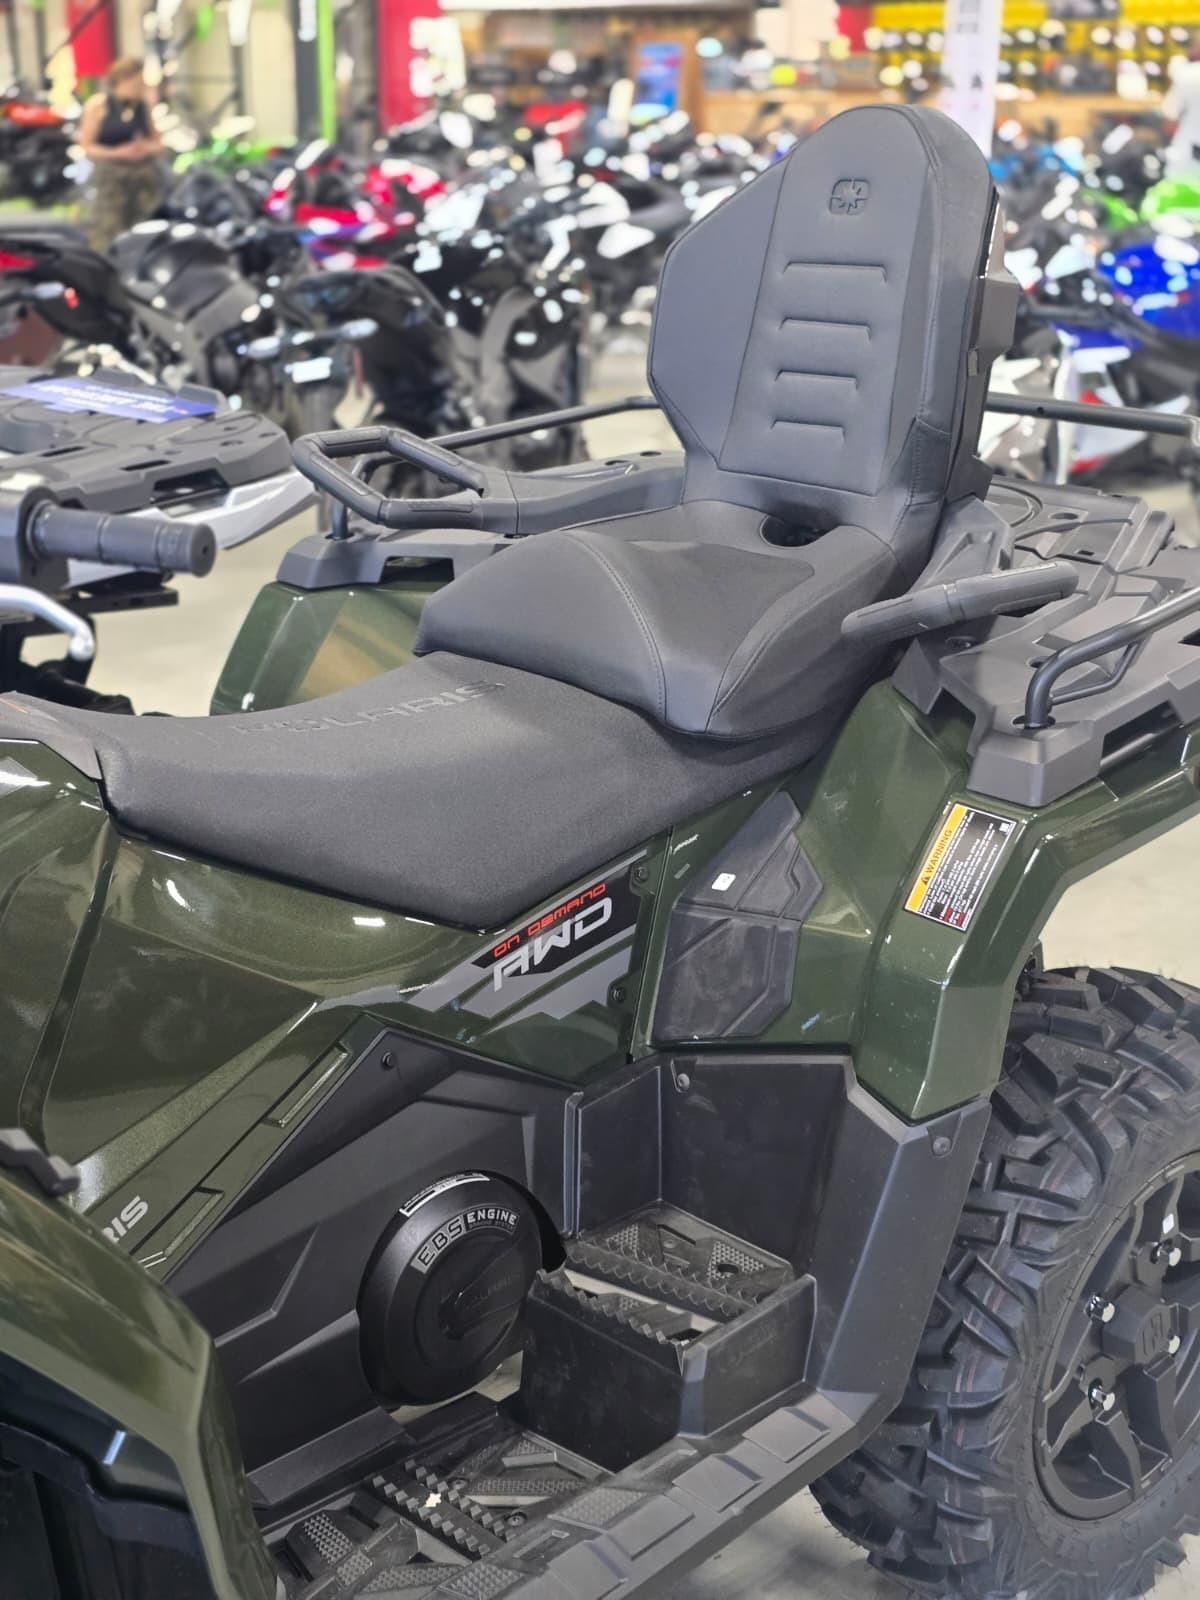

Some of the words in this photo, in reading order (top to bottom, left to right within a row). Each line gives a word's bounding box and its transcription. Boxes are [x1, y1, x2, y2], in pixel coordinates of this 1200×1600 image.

[925, 829, 953, 874] WARNING
[527, 882, 607, 937] DEMAND
[493, 897, 613, 993] AWD
[417, 1217, 463, 1267] EBS
[466, 1208, 518, 1226] ENGINE
